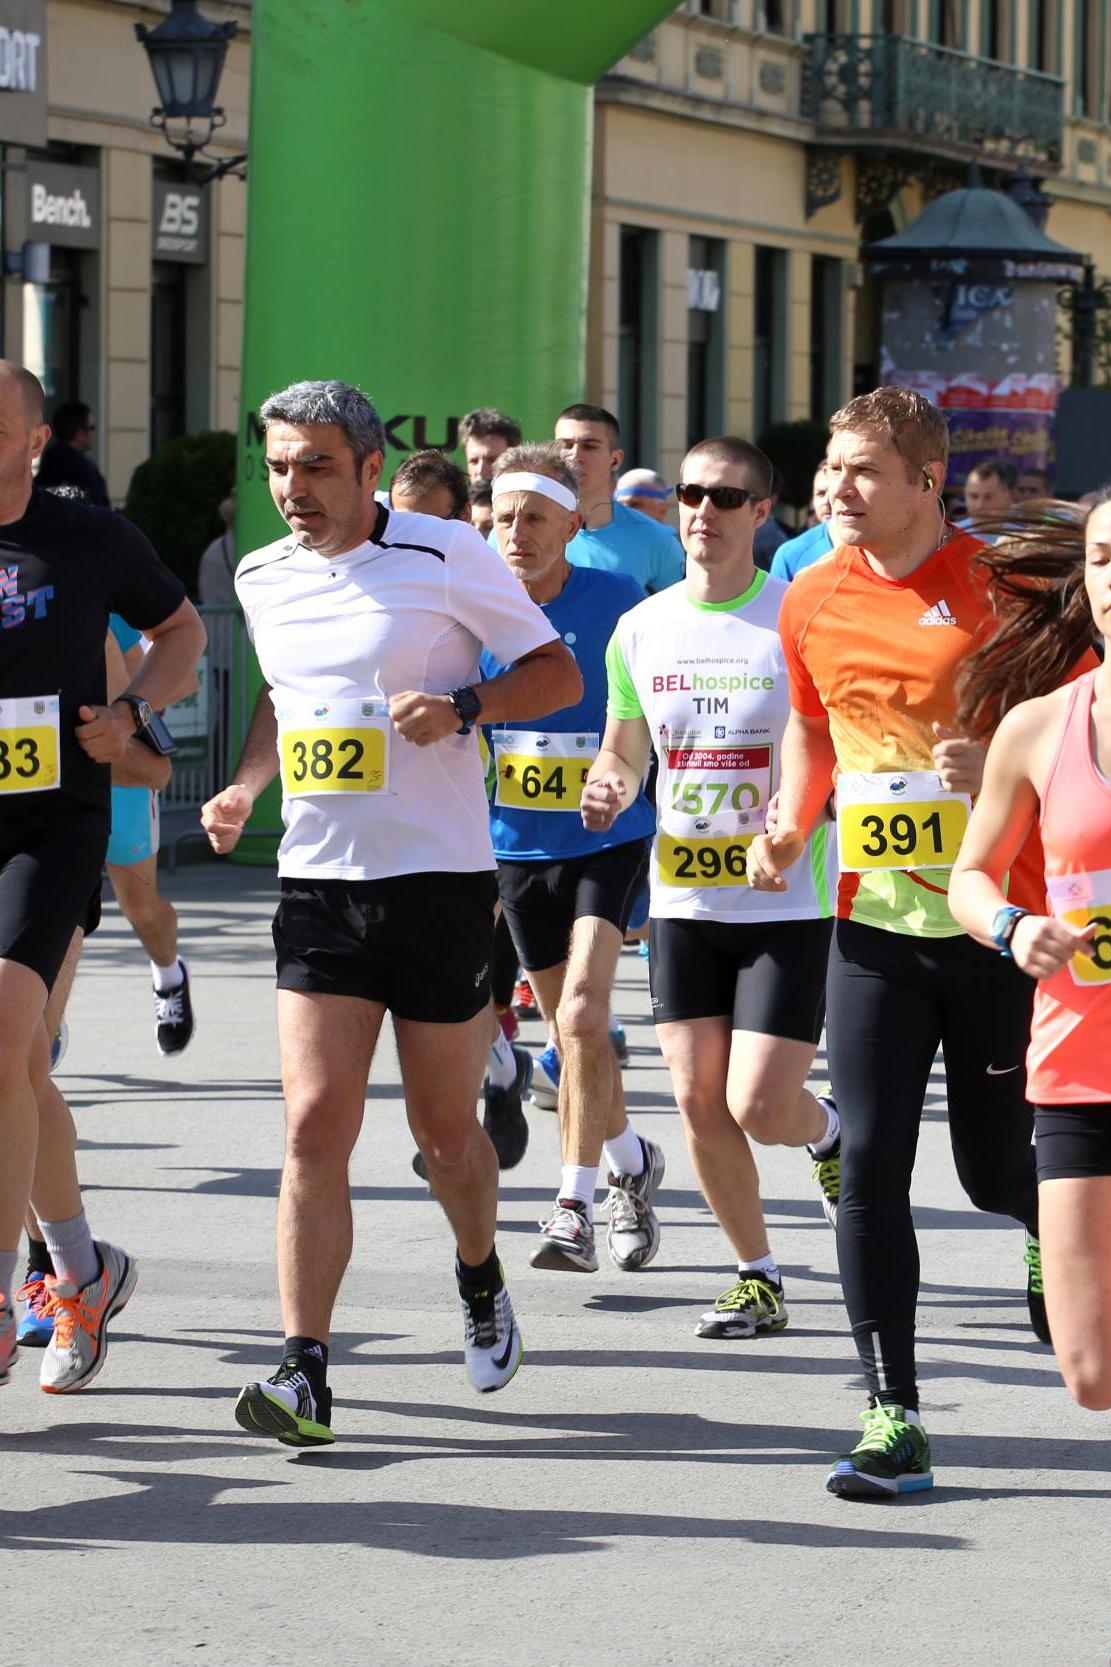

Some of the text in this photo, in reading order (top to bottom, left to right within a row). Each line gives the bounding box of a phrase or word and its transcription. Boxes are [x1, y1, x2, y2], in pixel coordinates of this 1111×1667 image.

[31, 183, 92, 228] Bench.
[160, 193, 200, 236] BS
[918, 615, 957, 626] adidas
[677, 656, 749, 666] www.belhospice.org
[652, 671, 775, 693] BELhospice
[692, 697, 729, 715] TIM
[727, 727, 771, 736] ALPHA BANK
[292, 738, 365, 782] 382
[693, 751, 715, 761] 2004.
[716, 751, 744, 762] godine
[738, 759, 750, 767] od
[522, 765, 567, 799] 64
[861, 811, 943, 857] 391
[673, 844, 747, 878] 296
